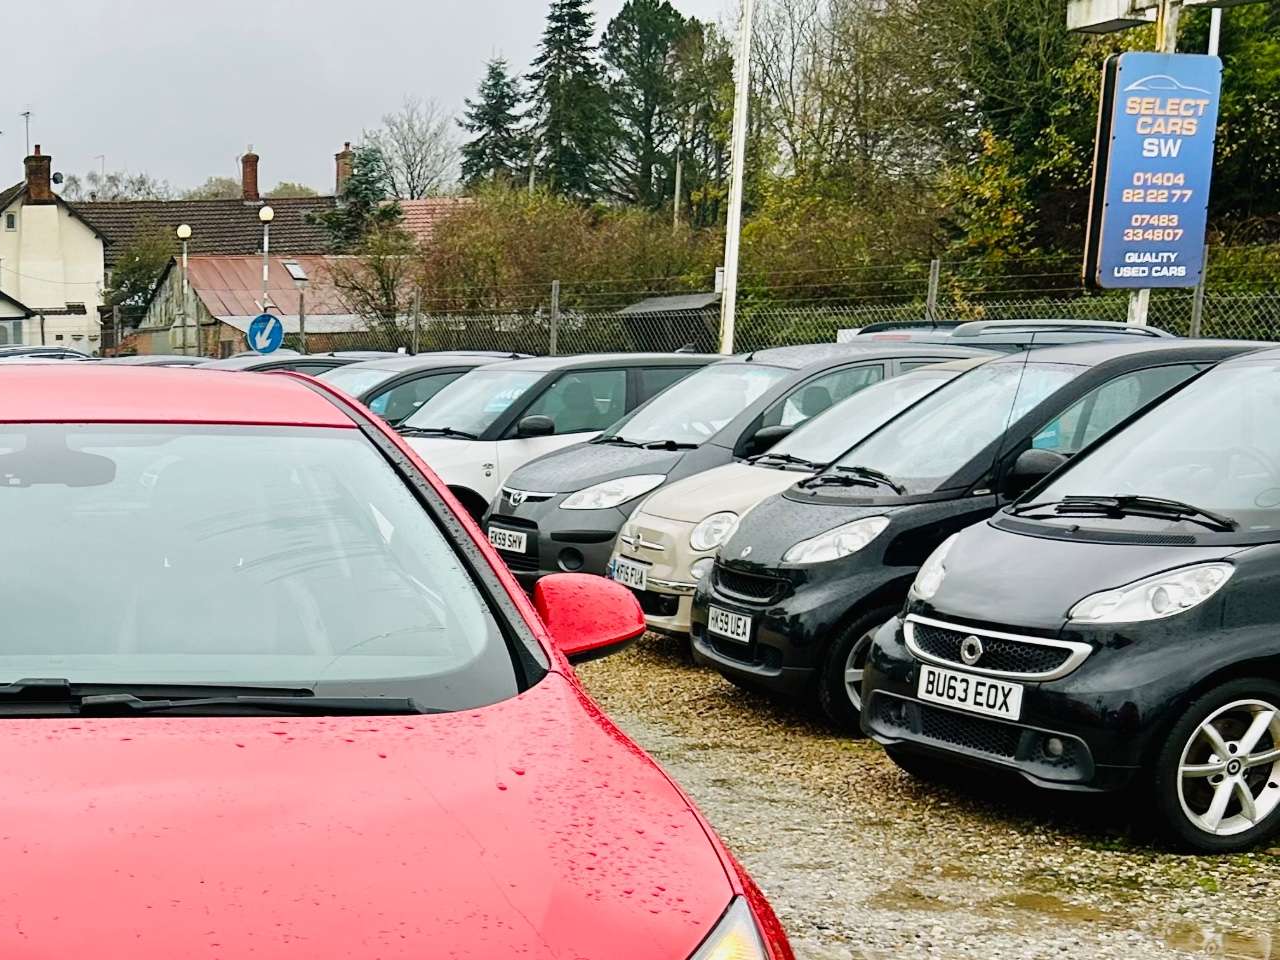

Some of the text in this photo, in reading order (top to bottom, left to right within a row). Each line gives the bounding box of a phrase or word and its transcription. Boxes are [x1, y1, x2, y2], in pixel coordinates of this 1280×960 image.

[1125, 97, 1209, 116] SELECT
[1136, 117, 1197, 136] CARS
[1142, 138, 1182, 157] SW
[1133, 172, 1185, 186] 01404
[1131, 214, 1178, 227] 07483
[1123, 229, 1183, 241] 334807
[1125, 252, 1178, 263] QUALITY
[1114, 266, 1186, 277] USED CARS
[730, 614, 747, 637] UEA
[925, 670, 1013, 713] BU63 EOX
